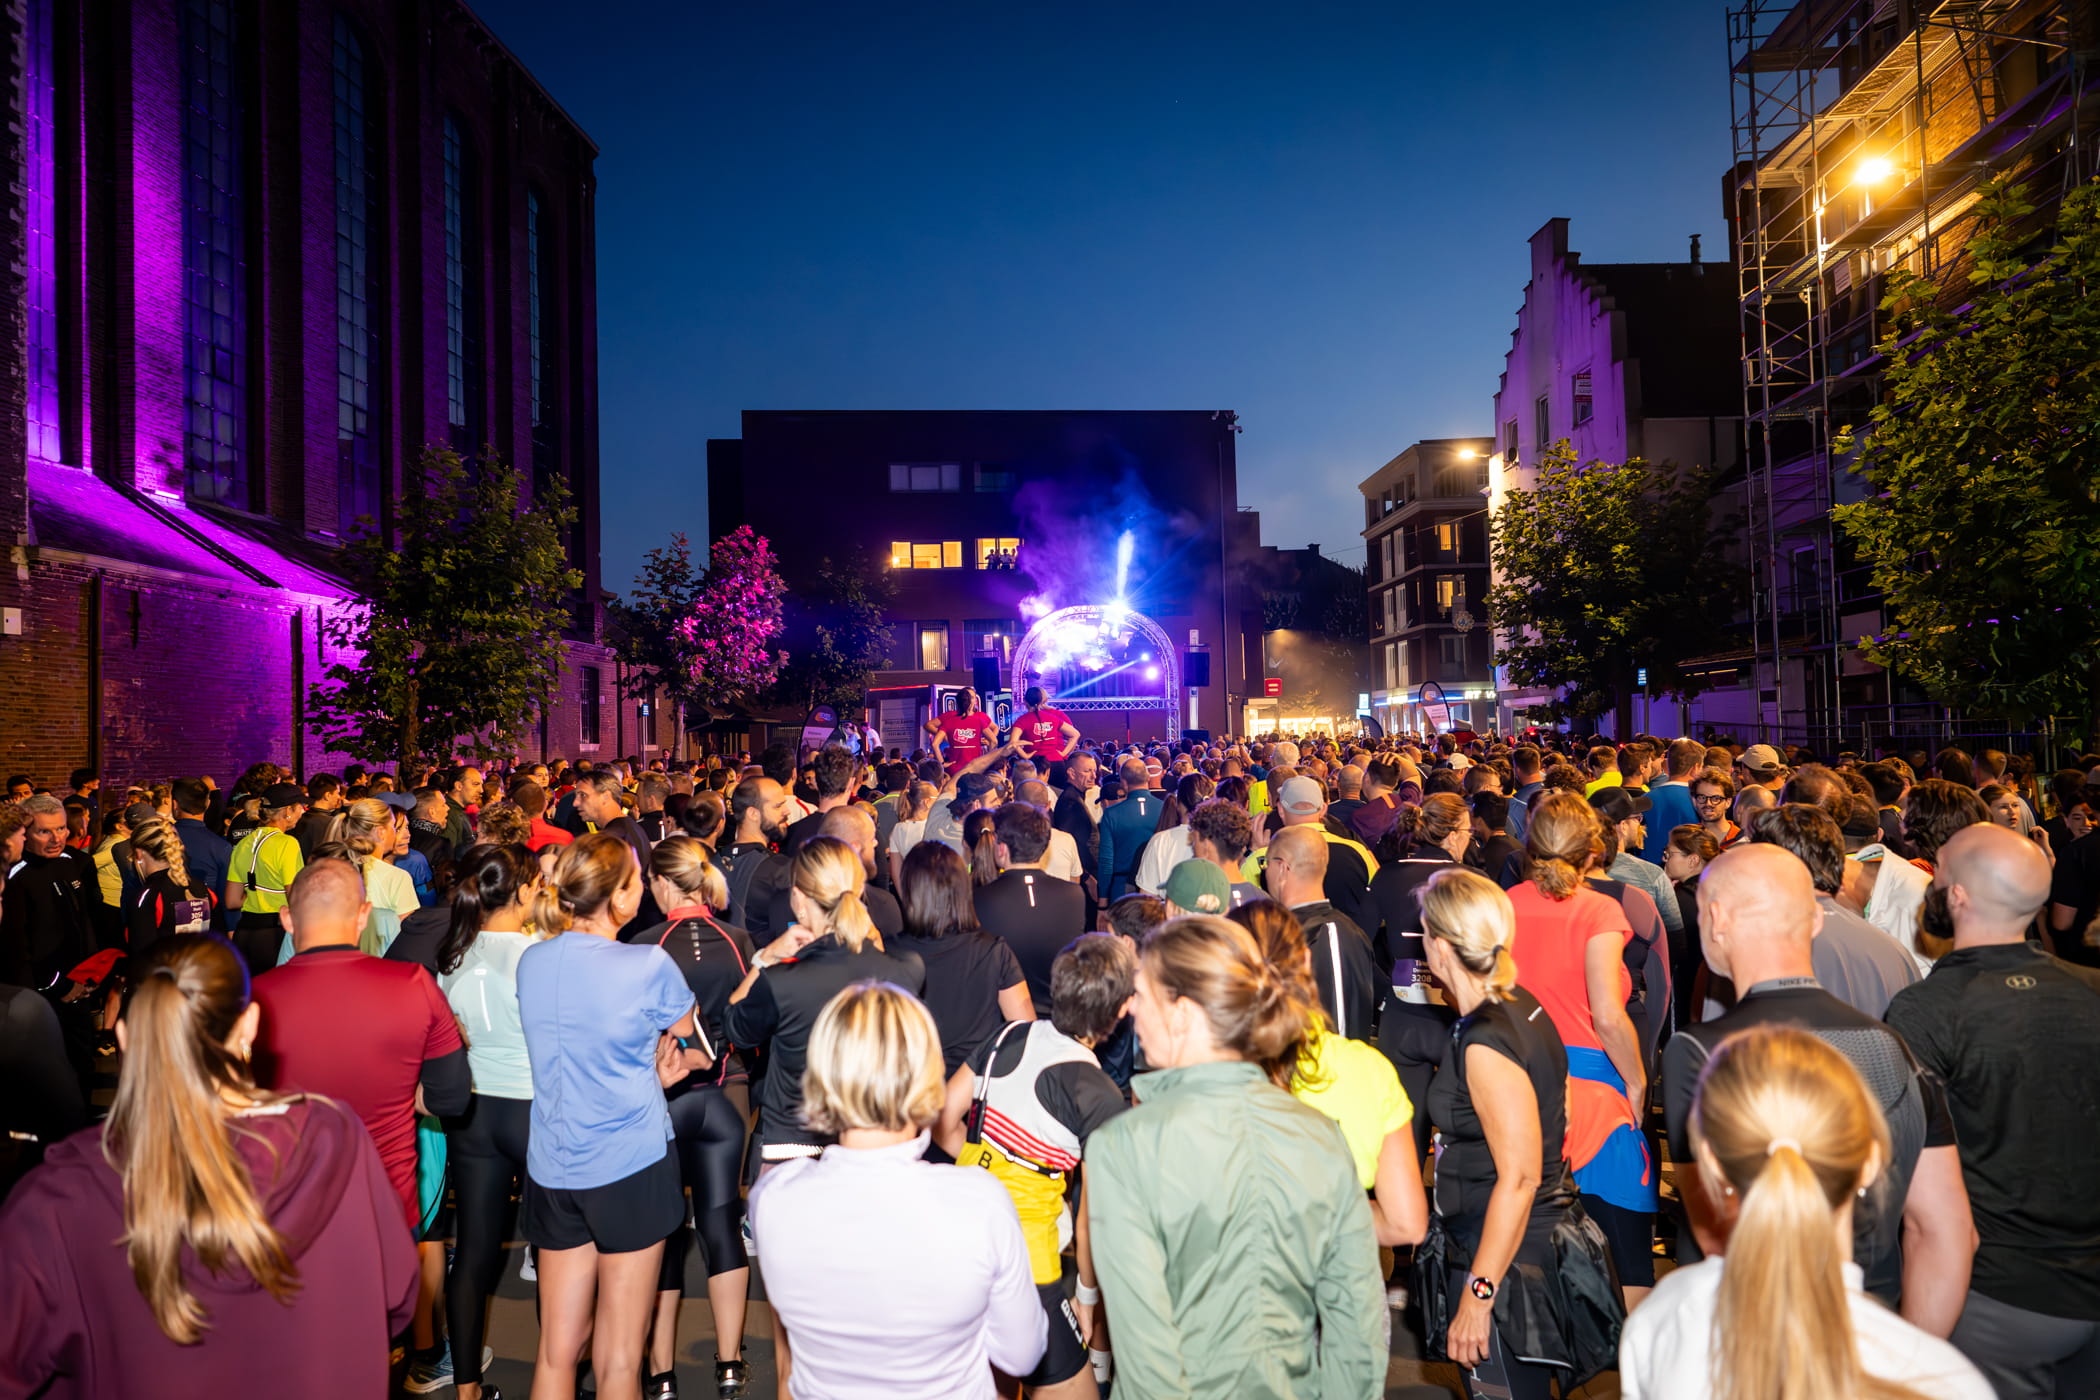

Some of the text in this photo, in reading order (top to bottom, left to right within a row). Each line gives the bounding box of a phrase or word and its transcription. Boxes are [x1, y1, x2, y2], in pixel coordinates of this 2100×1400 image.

[1411, 974, 1432, 983] 3208
[1779, 978, 1801, 986] NIKE
[978, 1150, 993, 1170] B
